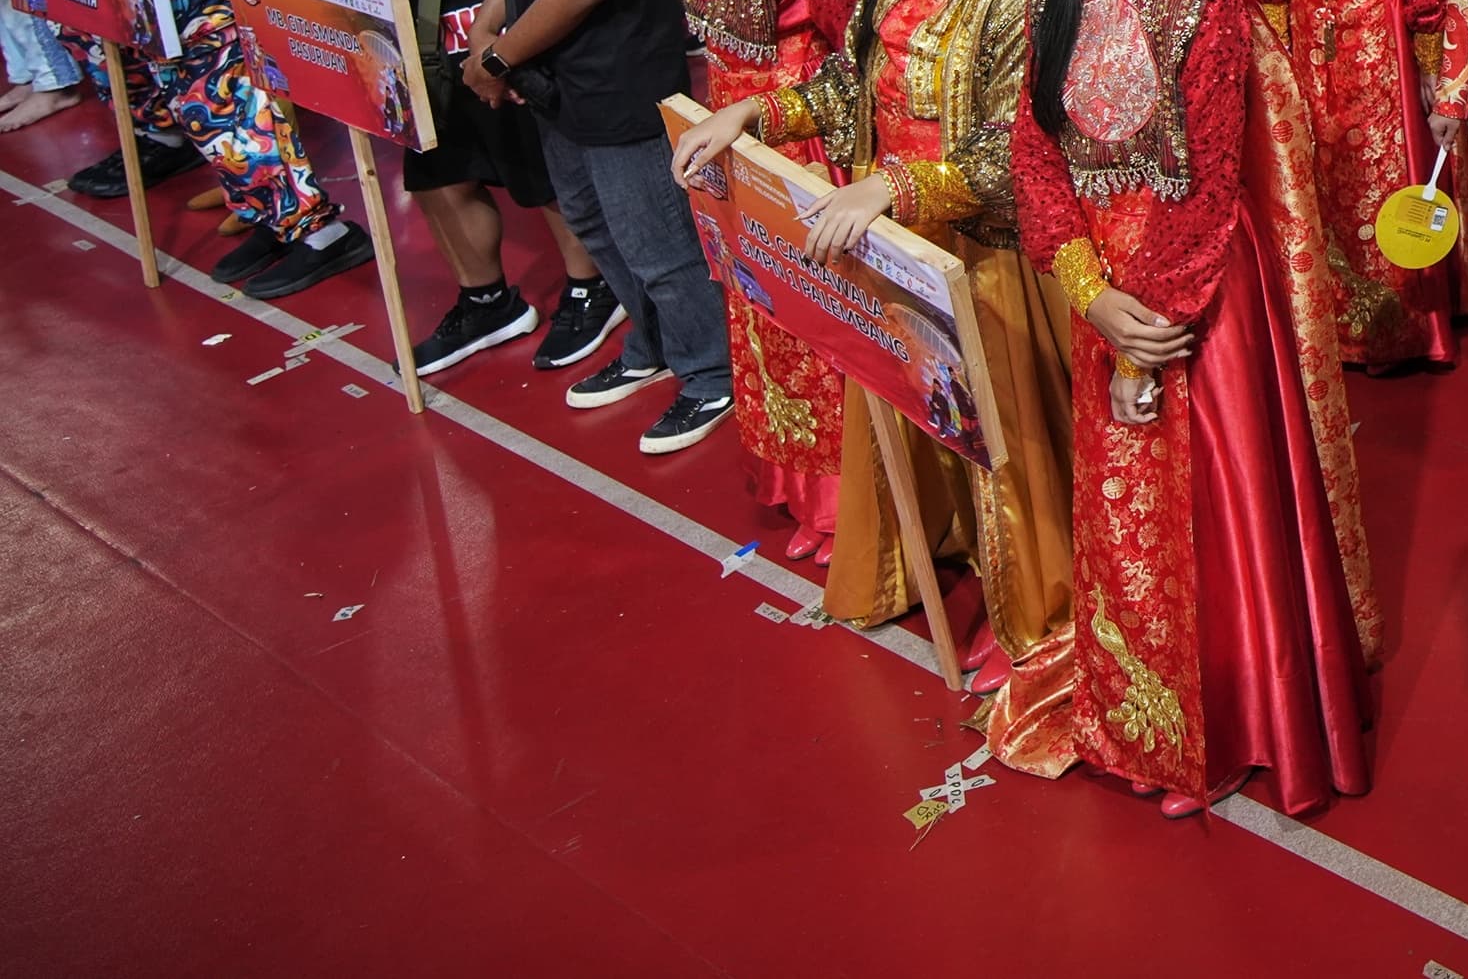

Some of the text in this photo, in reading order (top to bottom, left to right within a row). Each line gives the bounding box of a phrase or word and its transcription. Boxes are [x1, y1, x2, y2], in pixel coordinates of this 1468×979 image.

[287, 14, 313, 36] GITA
[312, 23, 363, 55] SMANDA
[288, 36, 348, 75] PASURUAN
[739, 234, 787, 283] SMPN
[788, 268, 800, 292] 1
[800, 272, 910, 364] PALEMBANG
[740, 212, 774, 251] MB.
[775, 233, 888, 322] CAKRAWALA
